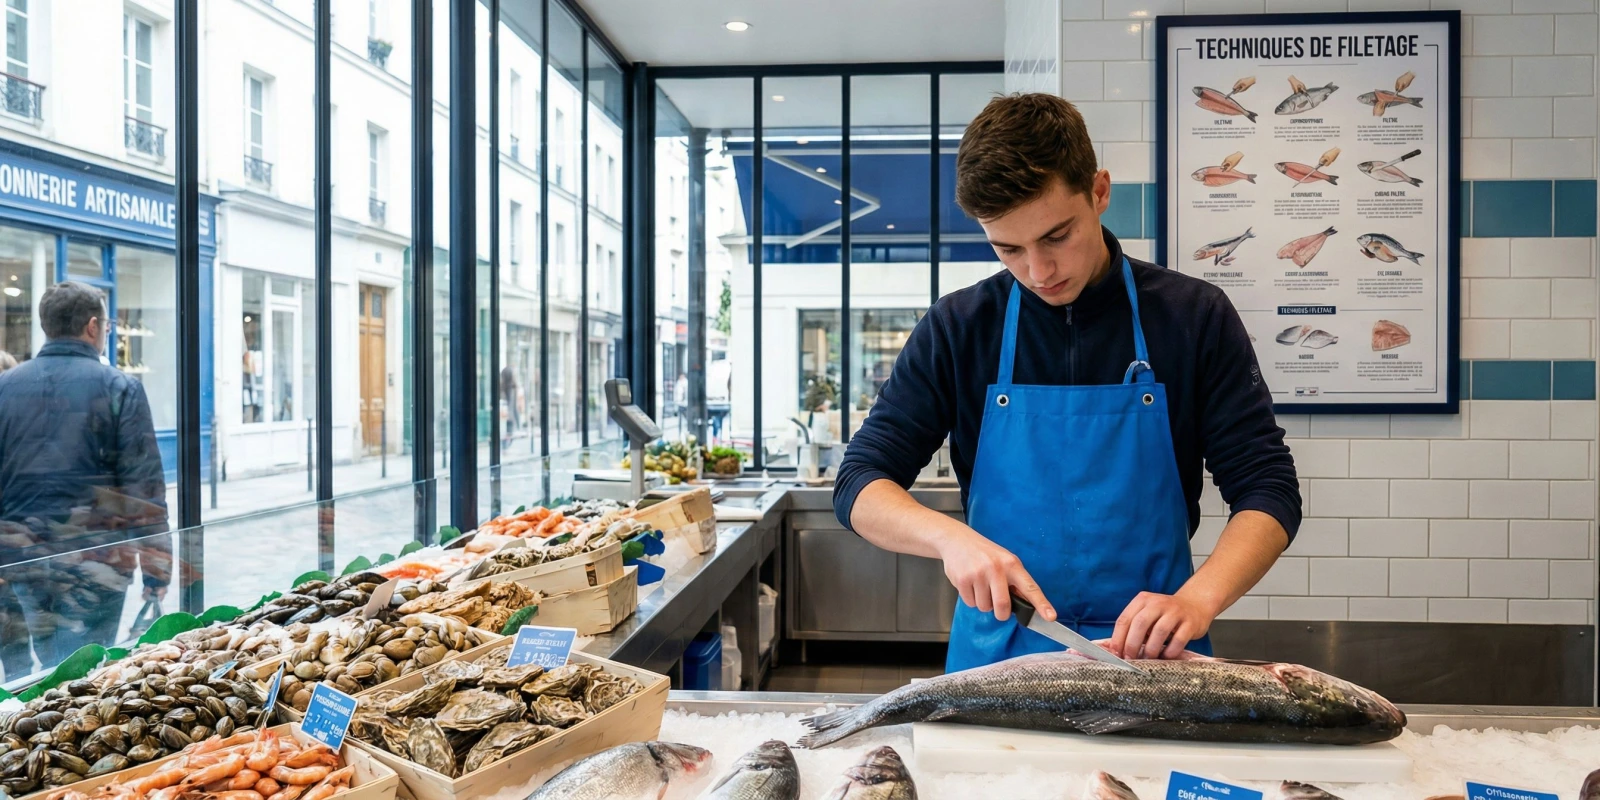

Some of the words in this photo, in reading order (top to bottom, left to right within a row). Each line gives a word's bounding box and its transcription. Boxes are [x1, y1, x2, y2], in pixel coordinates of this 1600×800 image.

[1195, 36, 1305, 60] TECHNIQUES
[1310, 36, 1333, 58] DE
[1337, 35, 1419, 57] FILETAGE
[0, 164, 77, 208] ONNERIE
[84, 184, 176, 230] ARTISANALE
